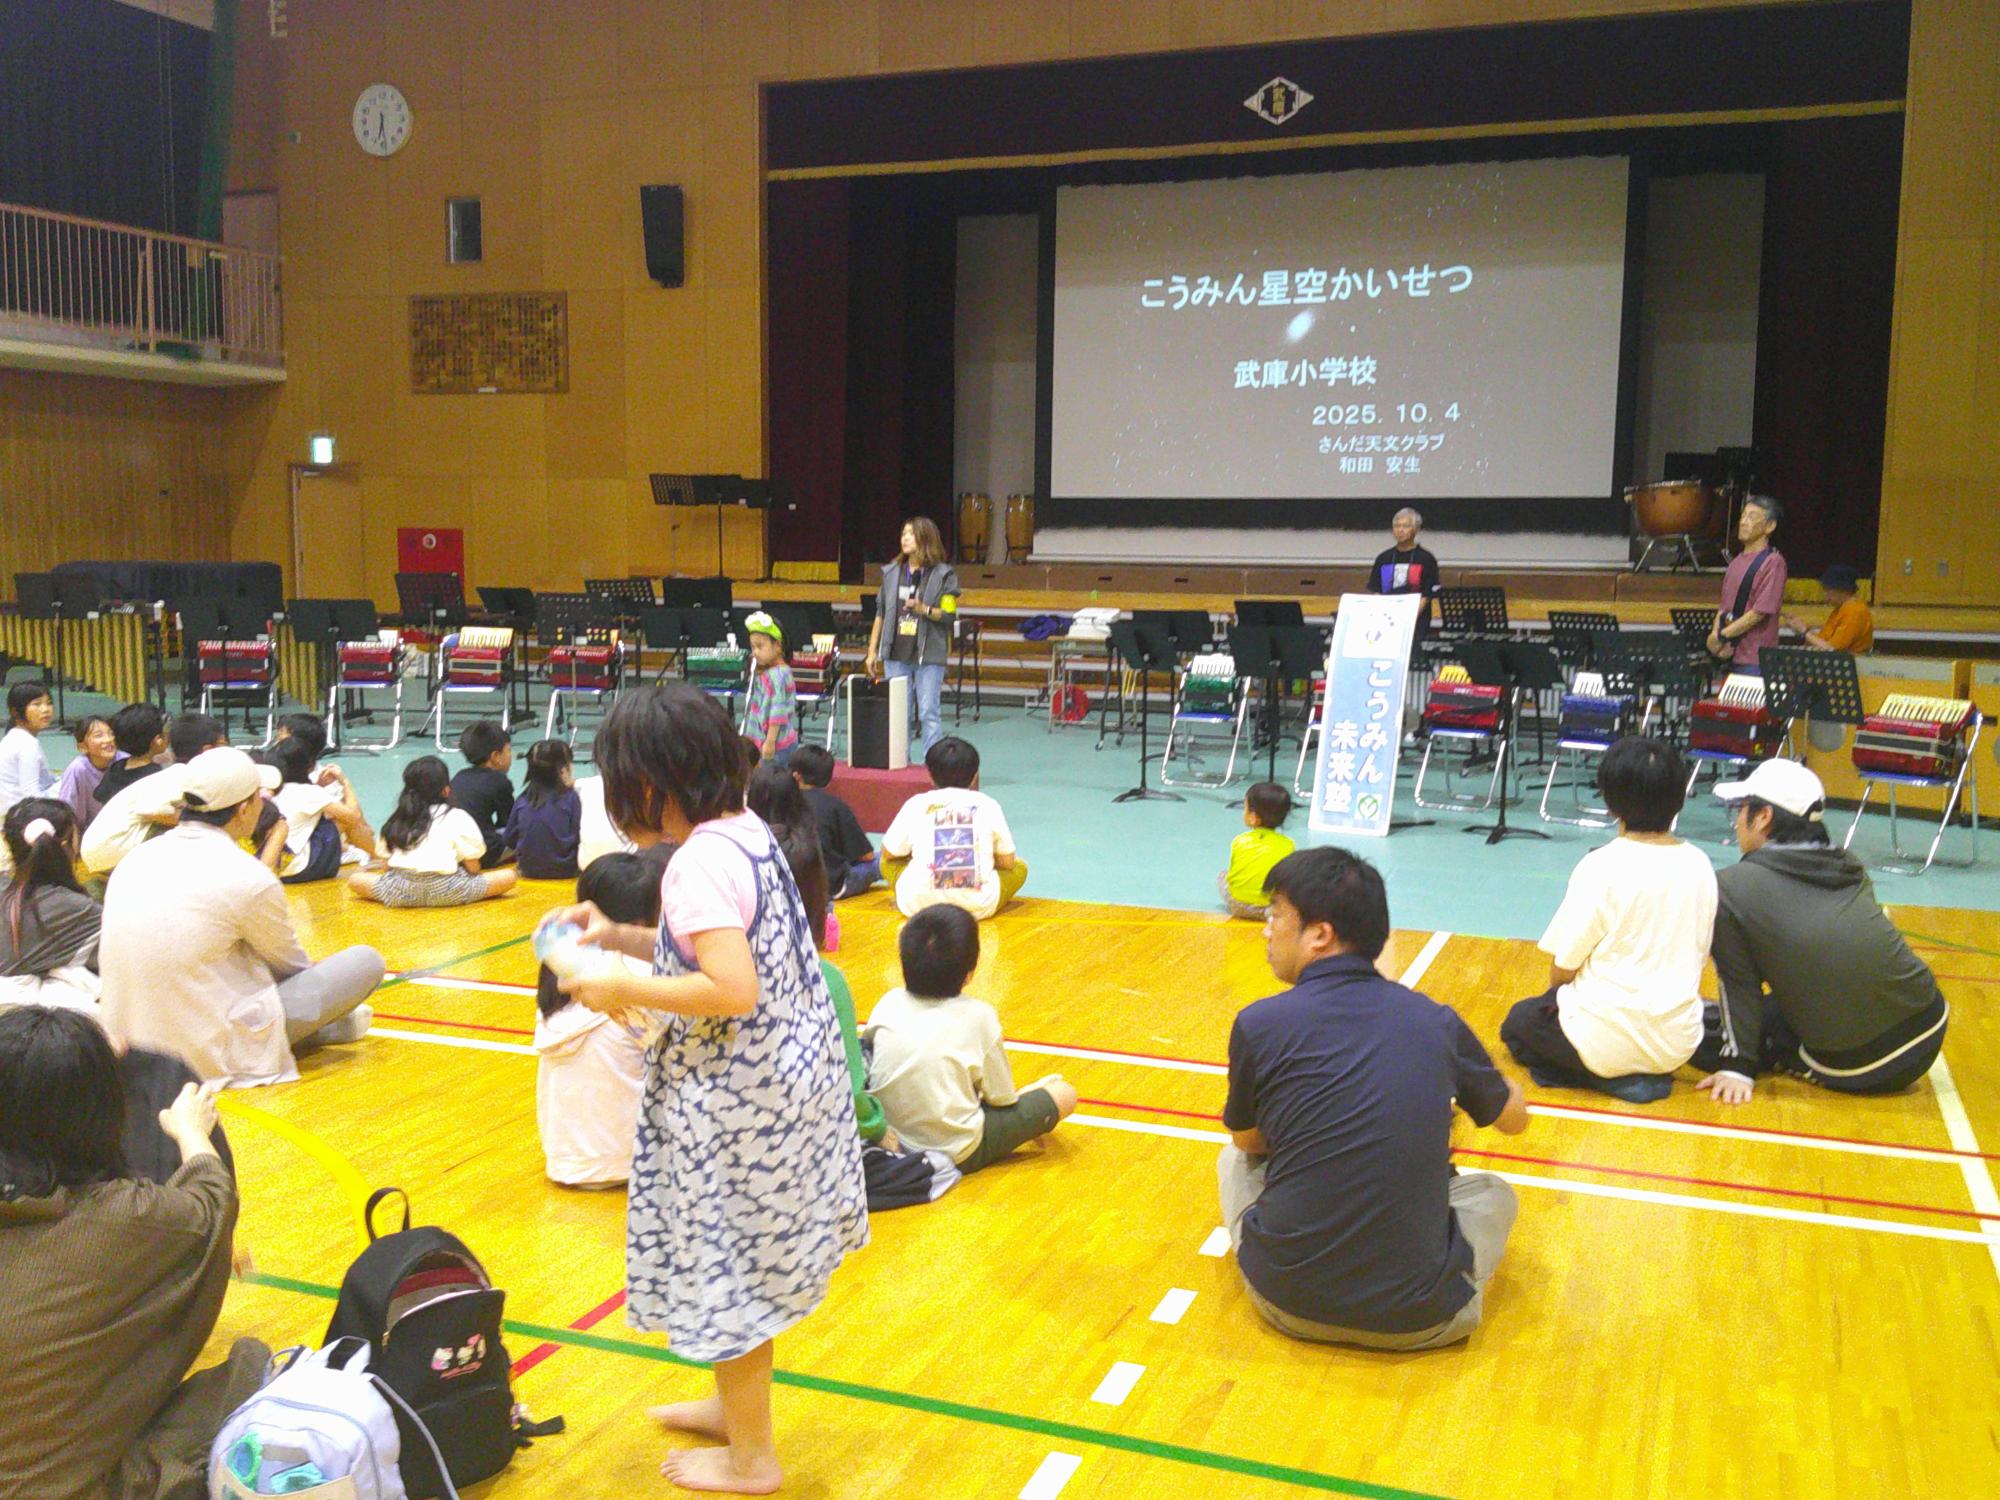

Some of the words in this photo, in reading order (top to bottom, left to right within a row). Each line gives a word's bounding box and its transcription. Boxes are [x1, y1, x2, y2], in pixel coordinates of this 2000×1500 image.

[1141, 263, 1473, 310] こうみん星空かいせつ
[1234, 355, 1377, 389] 武庫小学校
[1444, 401, 1462, 422] 4
[1319, 433, 1446, 454] さんだ天文クラブ
[1358, 660, 1392, 784] こうみん
[1323, 720, 1358, 812] 未来塾
